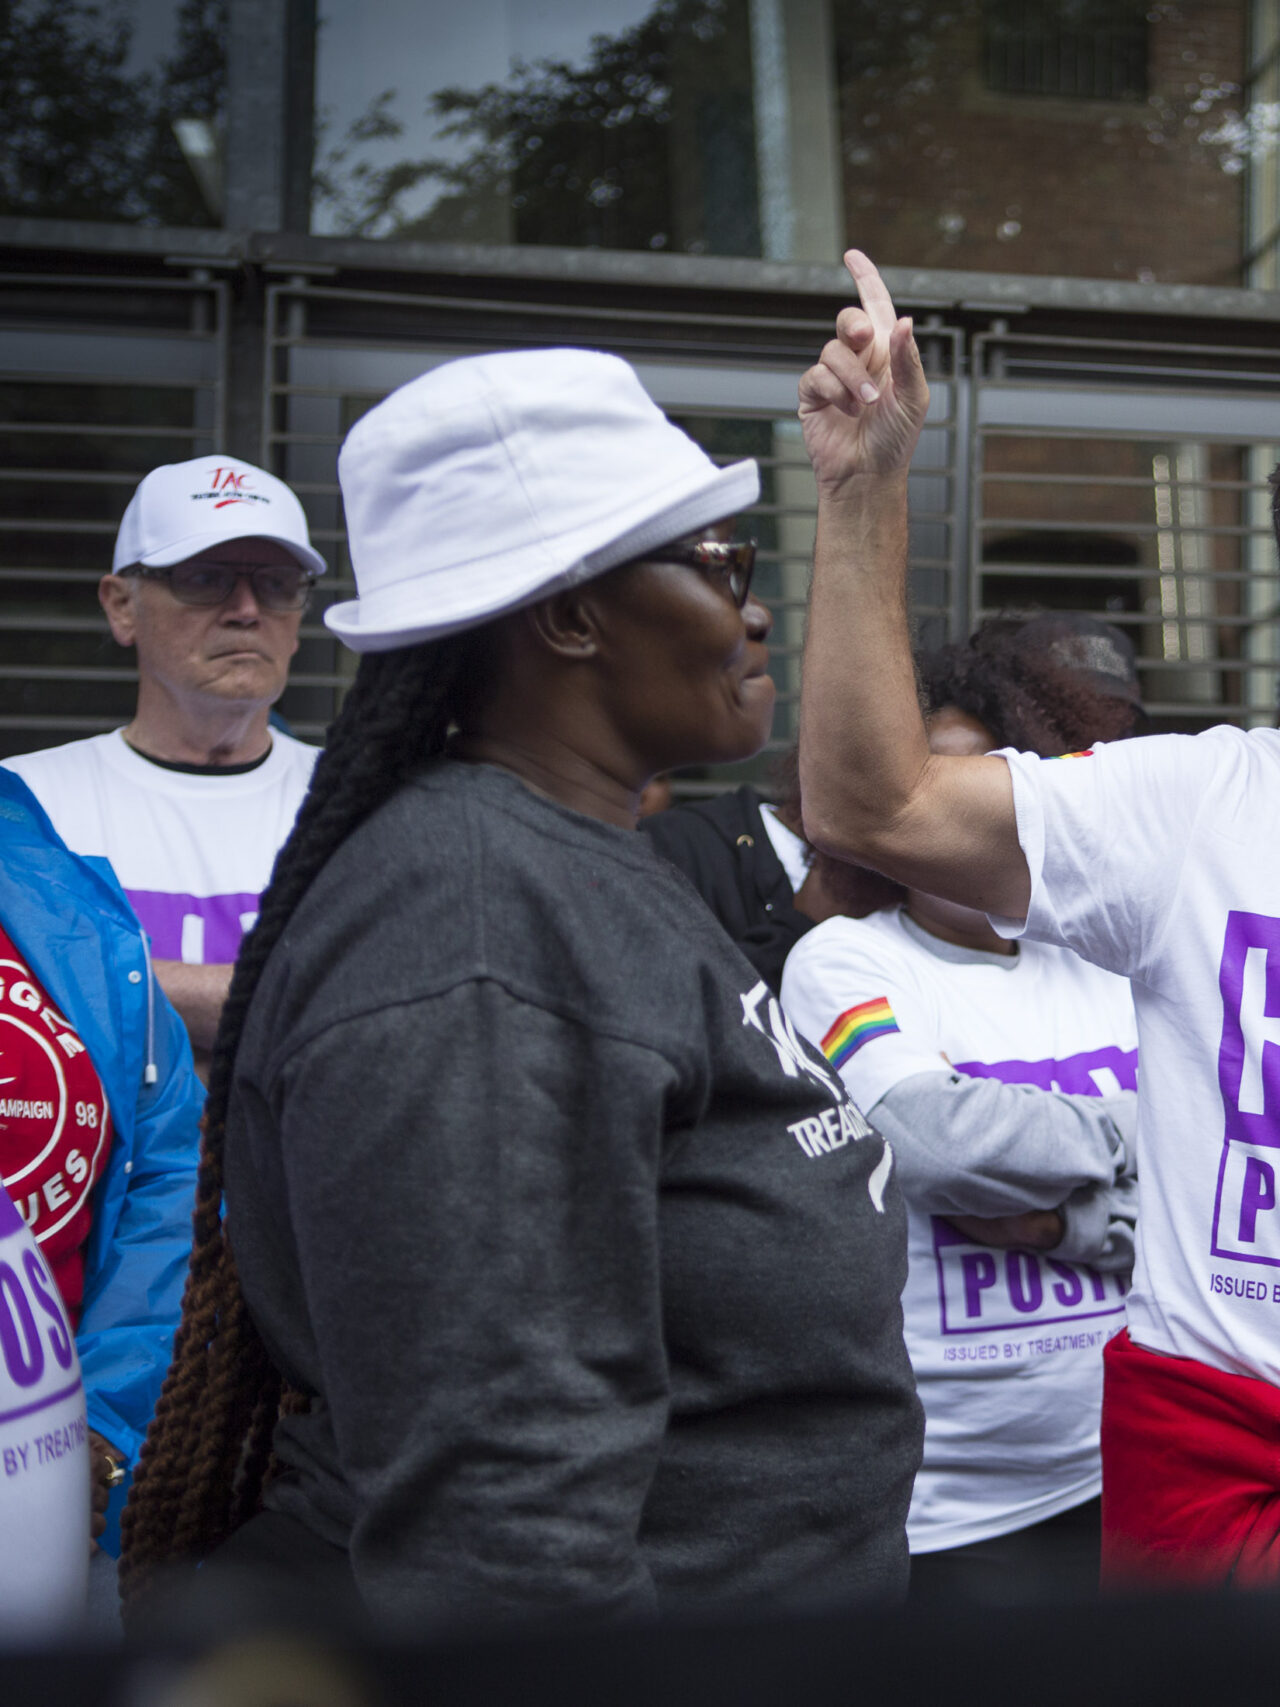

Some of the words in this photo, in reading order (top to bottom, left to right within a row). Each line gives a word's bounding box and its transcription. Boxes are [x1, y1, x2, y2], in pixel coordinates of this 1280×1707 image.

[206, 467, 252, 490] TAC
[75, 1101, 98, 1128] 98
[1210, 1273, 1268, 1301] ISSUED
[944, 1343, 998, 1362] ISSUED
[1003, 1344, 1022, 1360] BY
[1028, 1330, 1102, 1356] TREATMENT
[3, 1443, 29, 1478] BY
